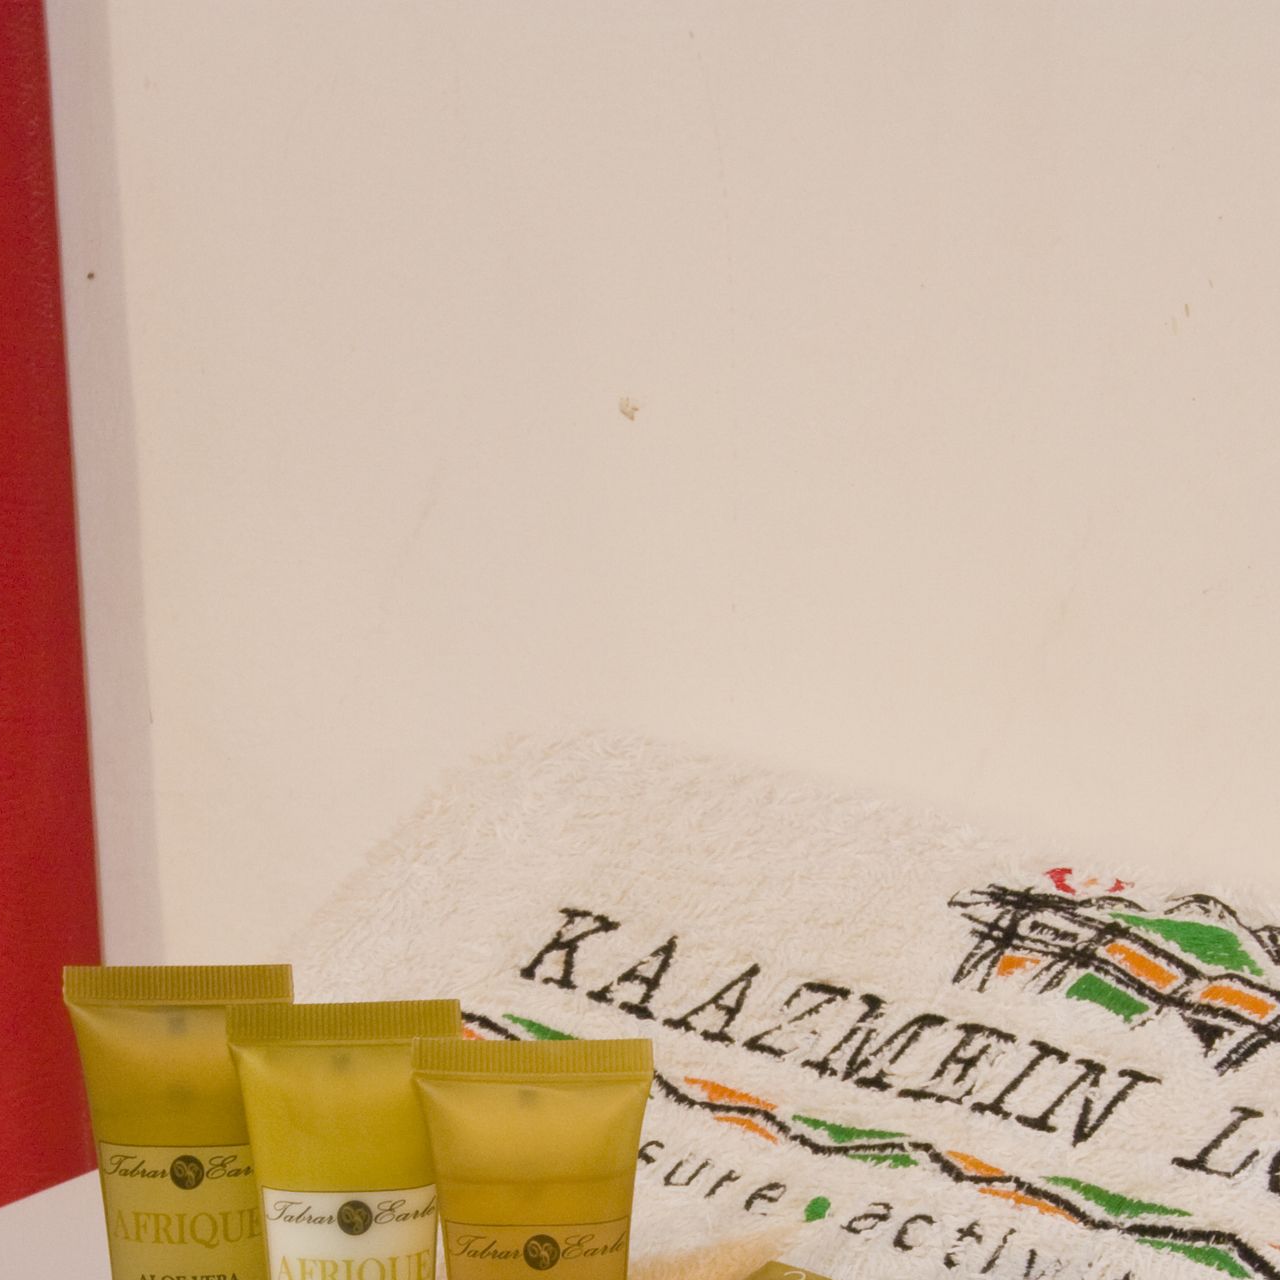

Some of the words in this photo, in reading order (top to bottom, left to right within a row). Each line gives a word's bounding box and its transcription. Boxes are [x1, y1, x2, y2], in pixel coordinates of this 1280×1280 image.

[520, 907, 1162, 1147] KAAZMEIN
[104, 1155, 169, 1179] Tabrar
[266, 1200, 335, 1224] Tabrar
[374, 1195, 436, 1224] Earle
[113, 1207, 263, 1248] AFRIQUE
[454, 1234, 522, 1260] Tabrar
